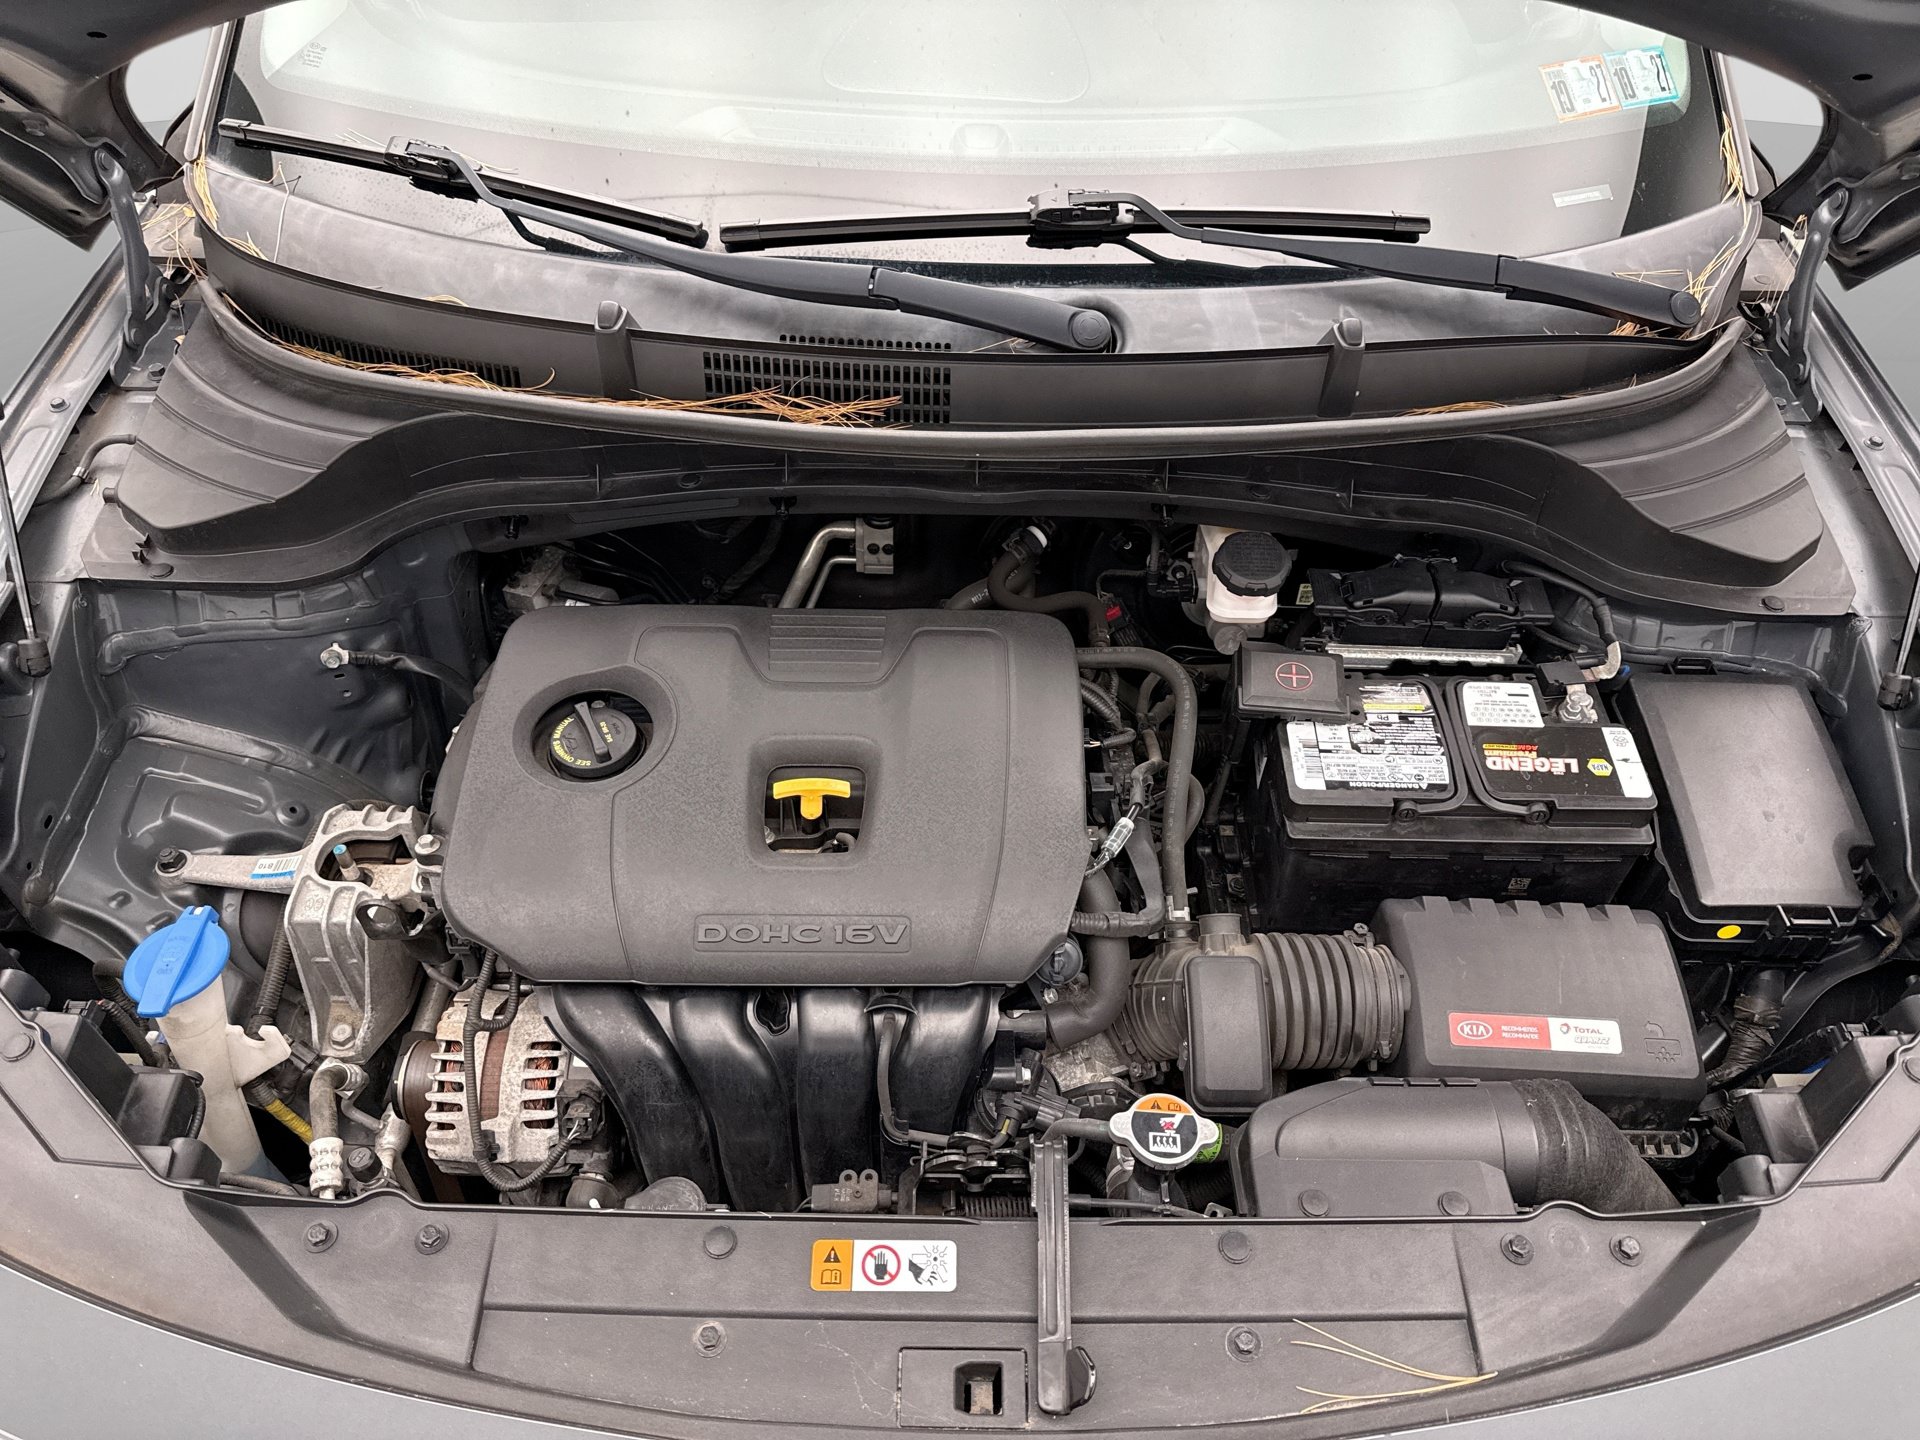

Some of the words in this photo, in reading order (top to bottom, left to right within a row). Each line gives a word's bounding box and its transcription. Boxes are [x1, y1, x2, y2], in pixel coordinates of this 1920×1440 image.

[1650, 53, 1671, 92] 27
[1589, 63, 1612, 104] 27
[553, 717, 575, 739] MANUAL
[553, 740, 575, 763] OWNER'S
[1483, 750, 1538, 759] Premium
[1485, 757, 1579, 773] LEGEND
[1592, 763, 1609, 771] NAPA
[1349, 781, 1419, 789] DANGER/POISON
[697, 923, 822, 943] DOHC
[834, 924, 908, 944] 16V
[1463, 1025, 1487, 1037] KIA
[1501, 1025, 1539, 1033] RECOMMENDS
[1573, 1026, 1603, 1034] TOTAL
